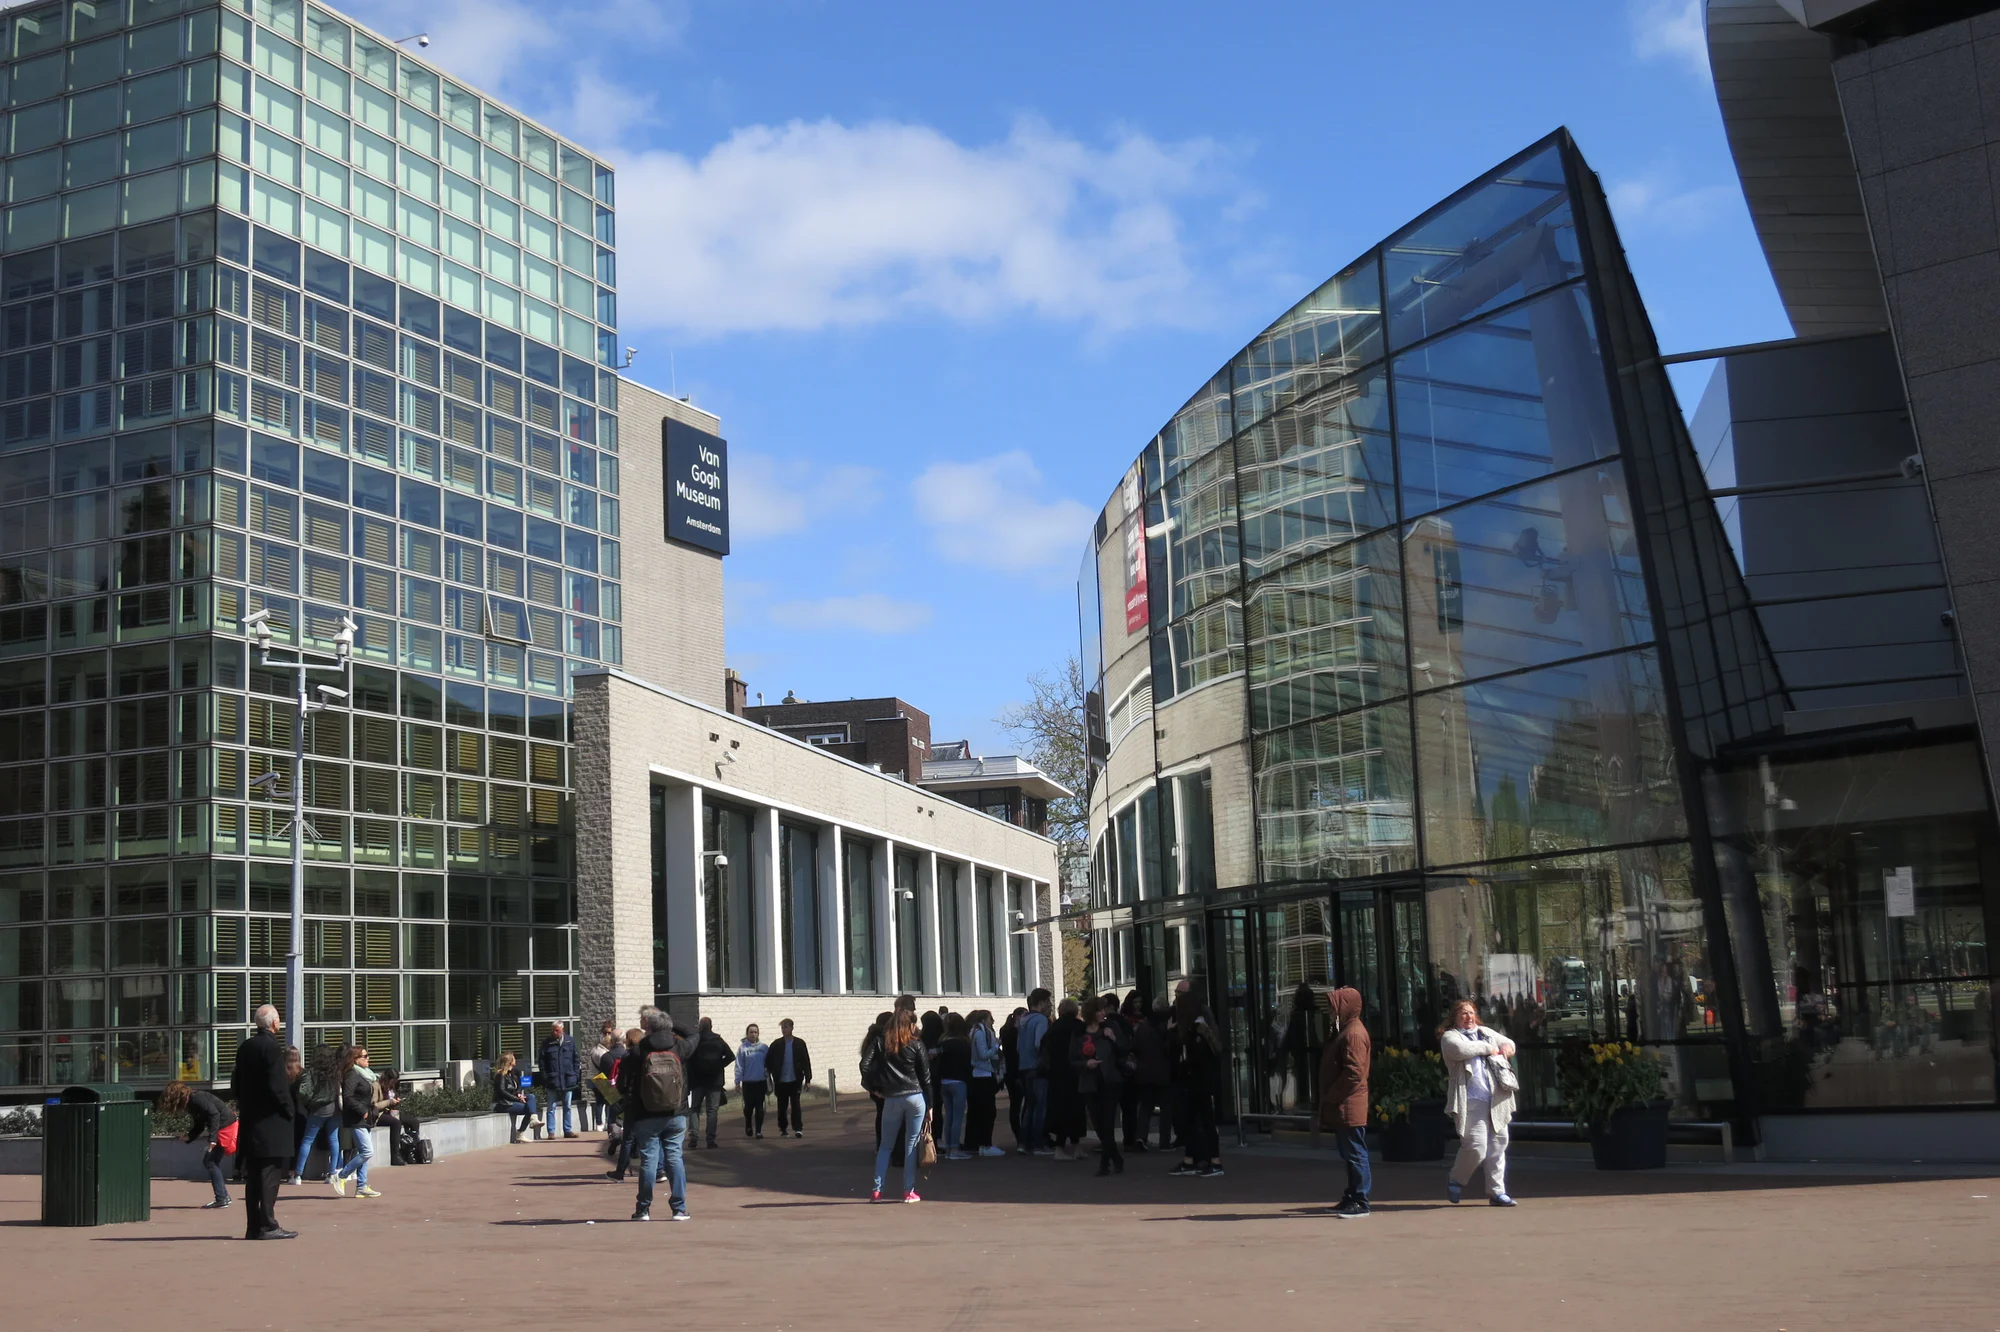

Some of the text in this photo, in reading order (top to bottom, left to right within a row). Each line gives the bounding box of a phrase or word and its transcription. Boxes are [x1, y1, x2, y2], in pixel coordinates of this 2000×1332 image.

[698, 444, 720, 468] Van
[691, 464, 720, 490] Gogh
[676, 480, 721, 511] Museum
[686, 515, 722, 535] Amsterdam
